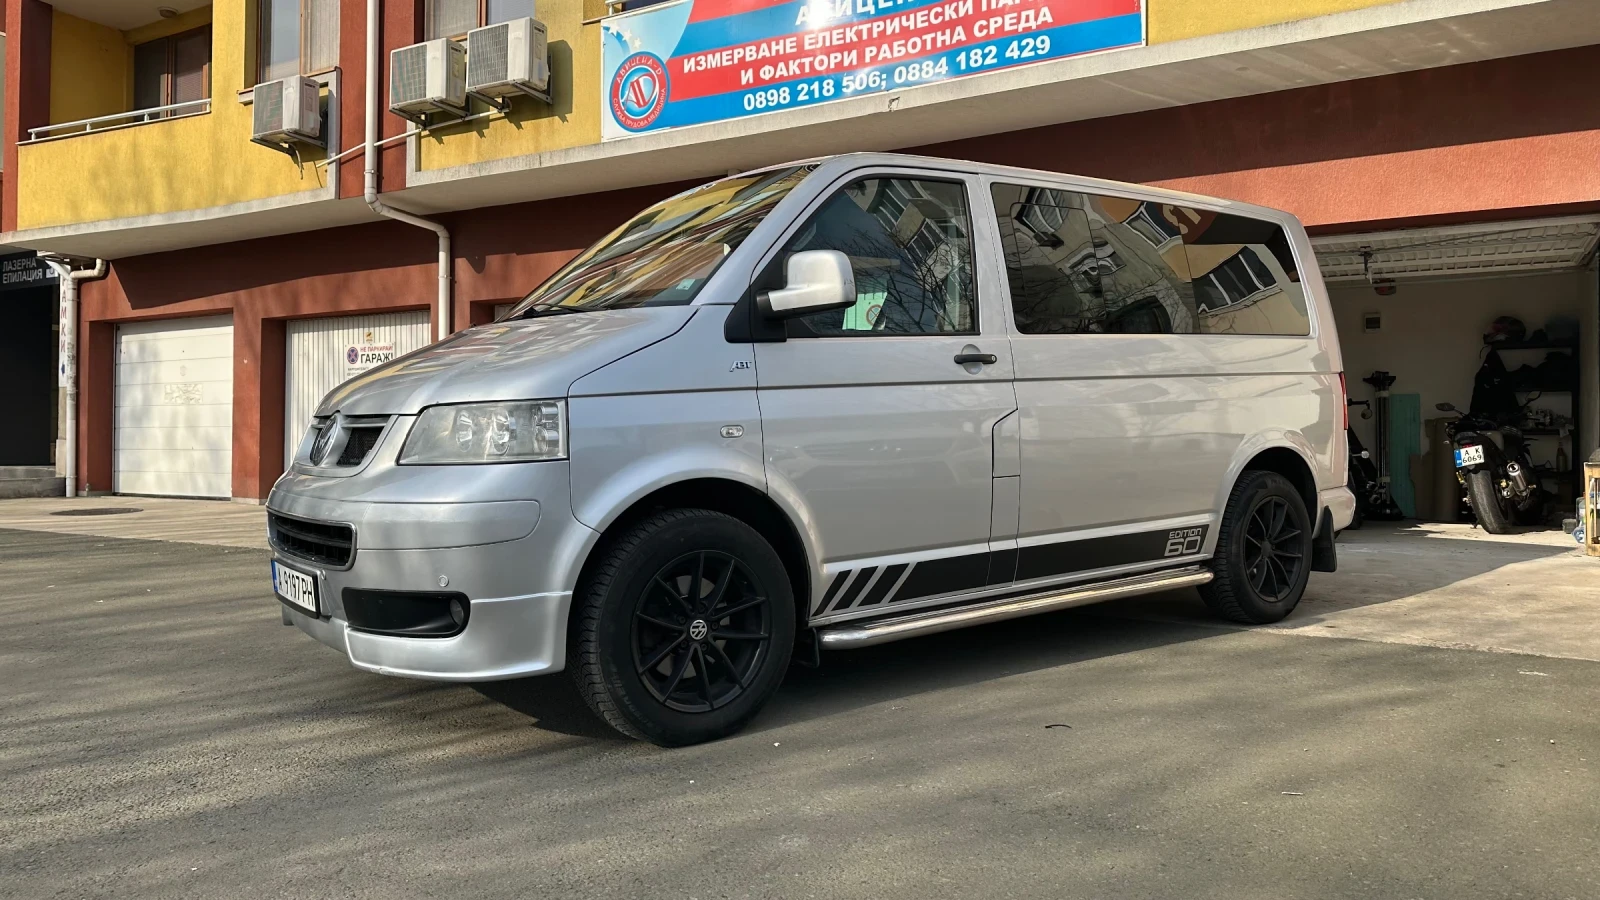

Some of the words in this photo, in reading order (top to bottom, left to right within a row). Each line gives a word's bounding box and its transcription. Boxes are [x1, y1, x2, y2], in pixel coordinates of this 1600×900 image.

[683, 37, 797, 73] ИЗМЕРВАНЕ
[803, 1, 974, 51] ЕЛЕКТРИЧЕСКИ
[740, 68, 754, 86] И
[759, 49, 858, 81] ФАКТОРИ
[864, 25, 967, 63] РАБОТНА
[973, 6, 1054, 38] СРЕДА
[743, 87, 790, 111] 0898
[797, 79, 835, 101] 218
[841, 71, 887, 93] 506;
[894, 56, 949, 84] 0884
[956, 45, 998, 70] 182
[1005, 35, 1051, 60] 429
[625, 117, 649, 128] ТРУДОВА
[2, 257, 37, 272] ЛАЗЕРНА
[2, 268, 43, 284] ЕПИЛАЦИЯ
[360, 352, 393, 364] ГАРАЖ!
[1462, 454, 1482, 464] 6069
[1168, 528, 1202, 539] EDITION
[1164, 535, 1201, 557] 60
